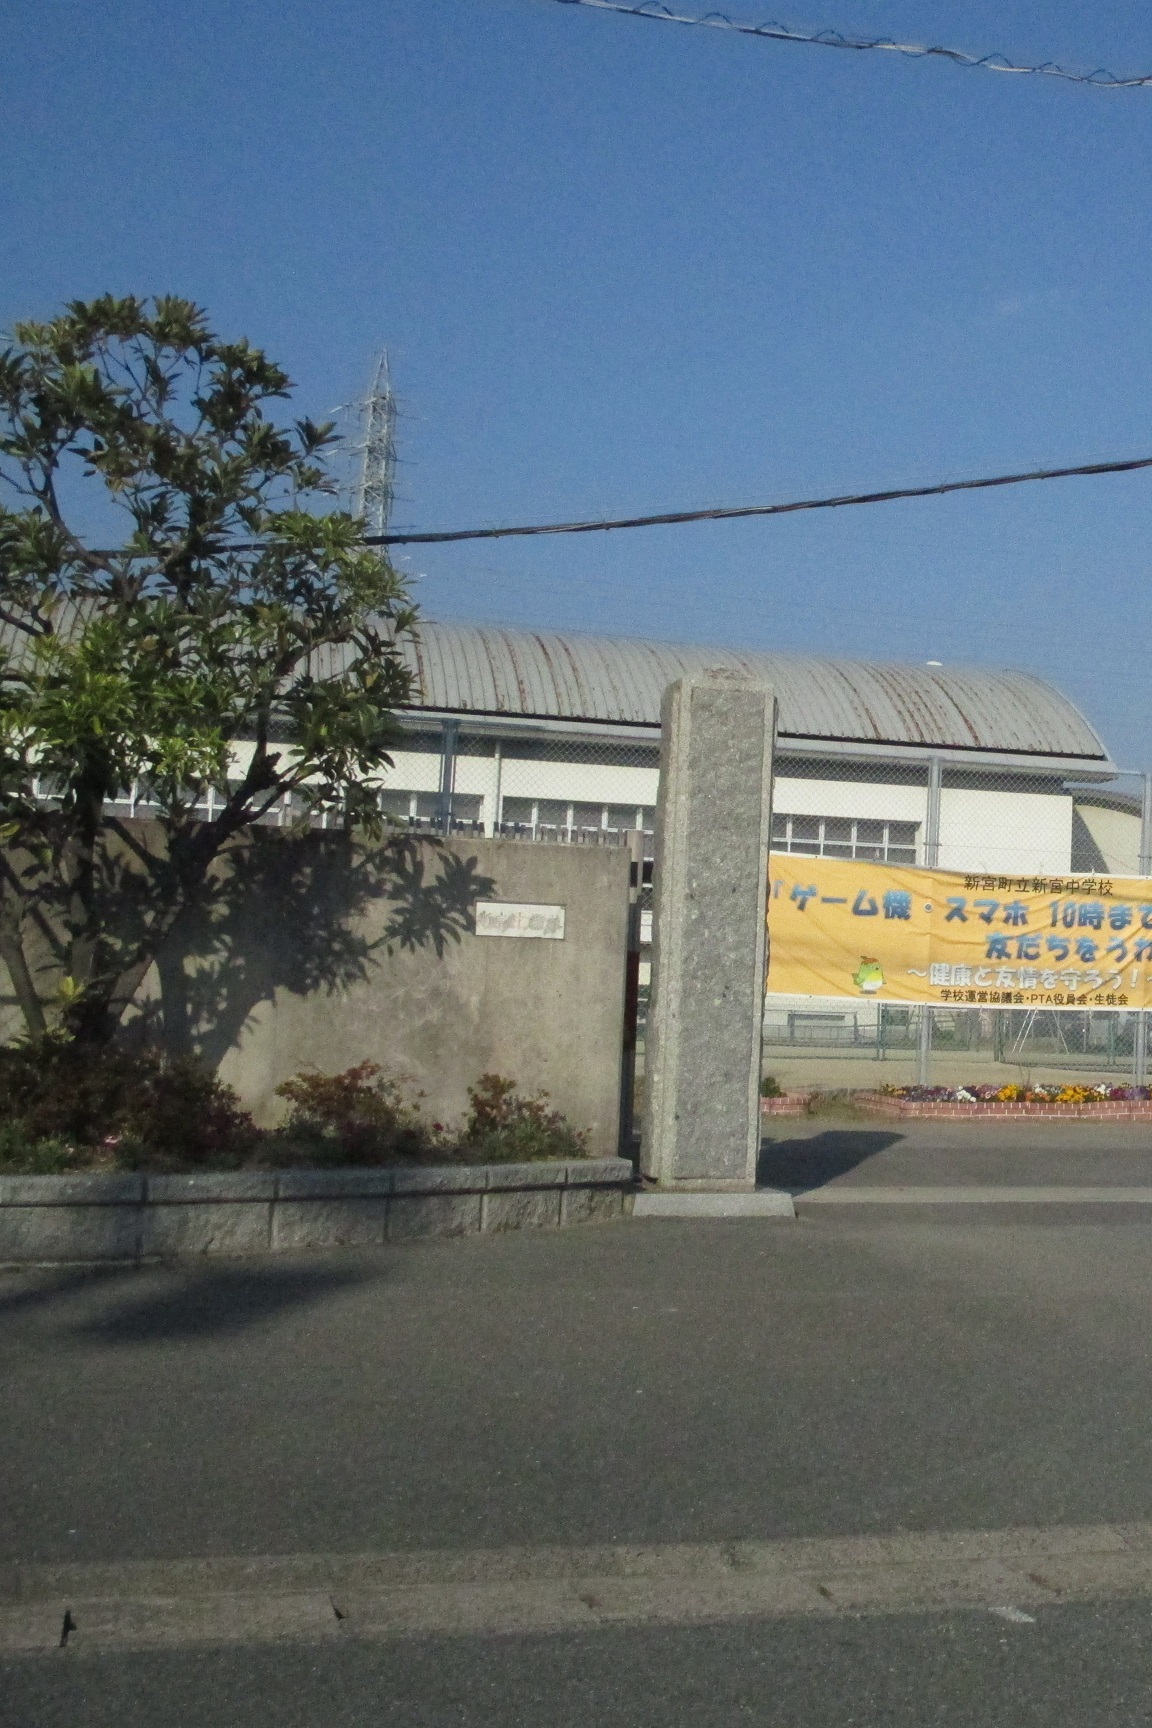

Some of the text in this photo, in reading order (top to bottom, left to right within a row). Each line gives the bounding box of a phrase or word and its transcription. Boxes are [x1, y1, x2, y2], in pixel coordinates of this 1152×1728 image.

[963, 874, 1114, 897] 新宮町立新宮中学校
